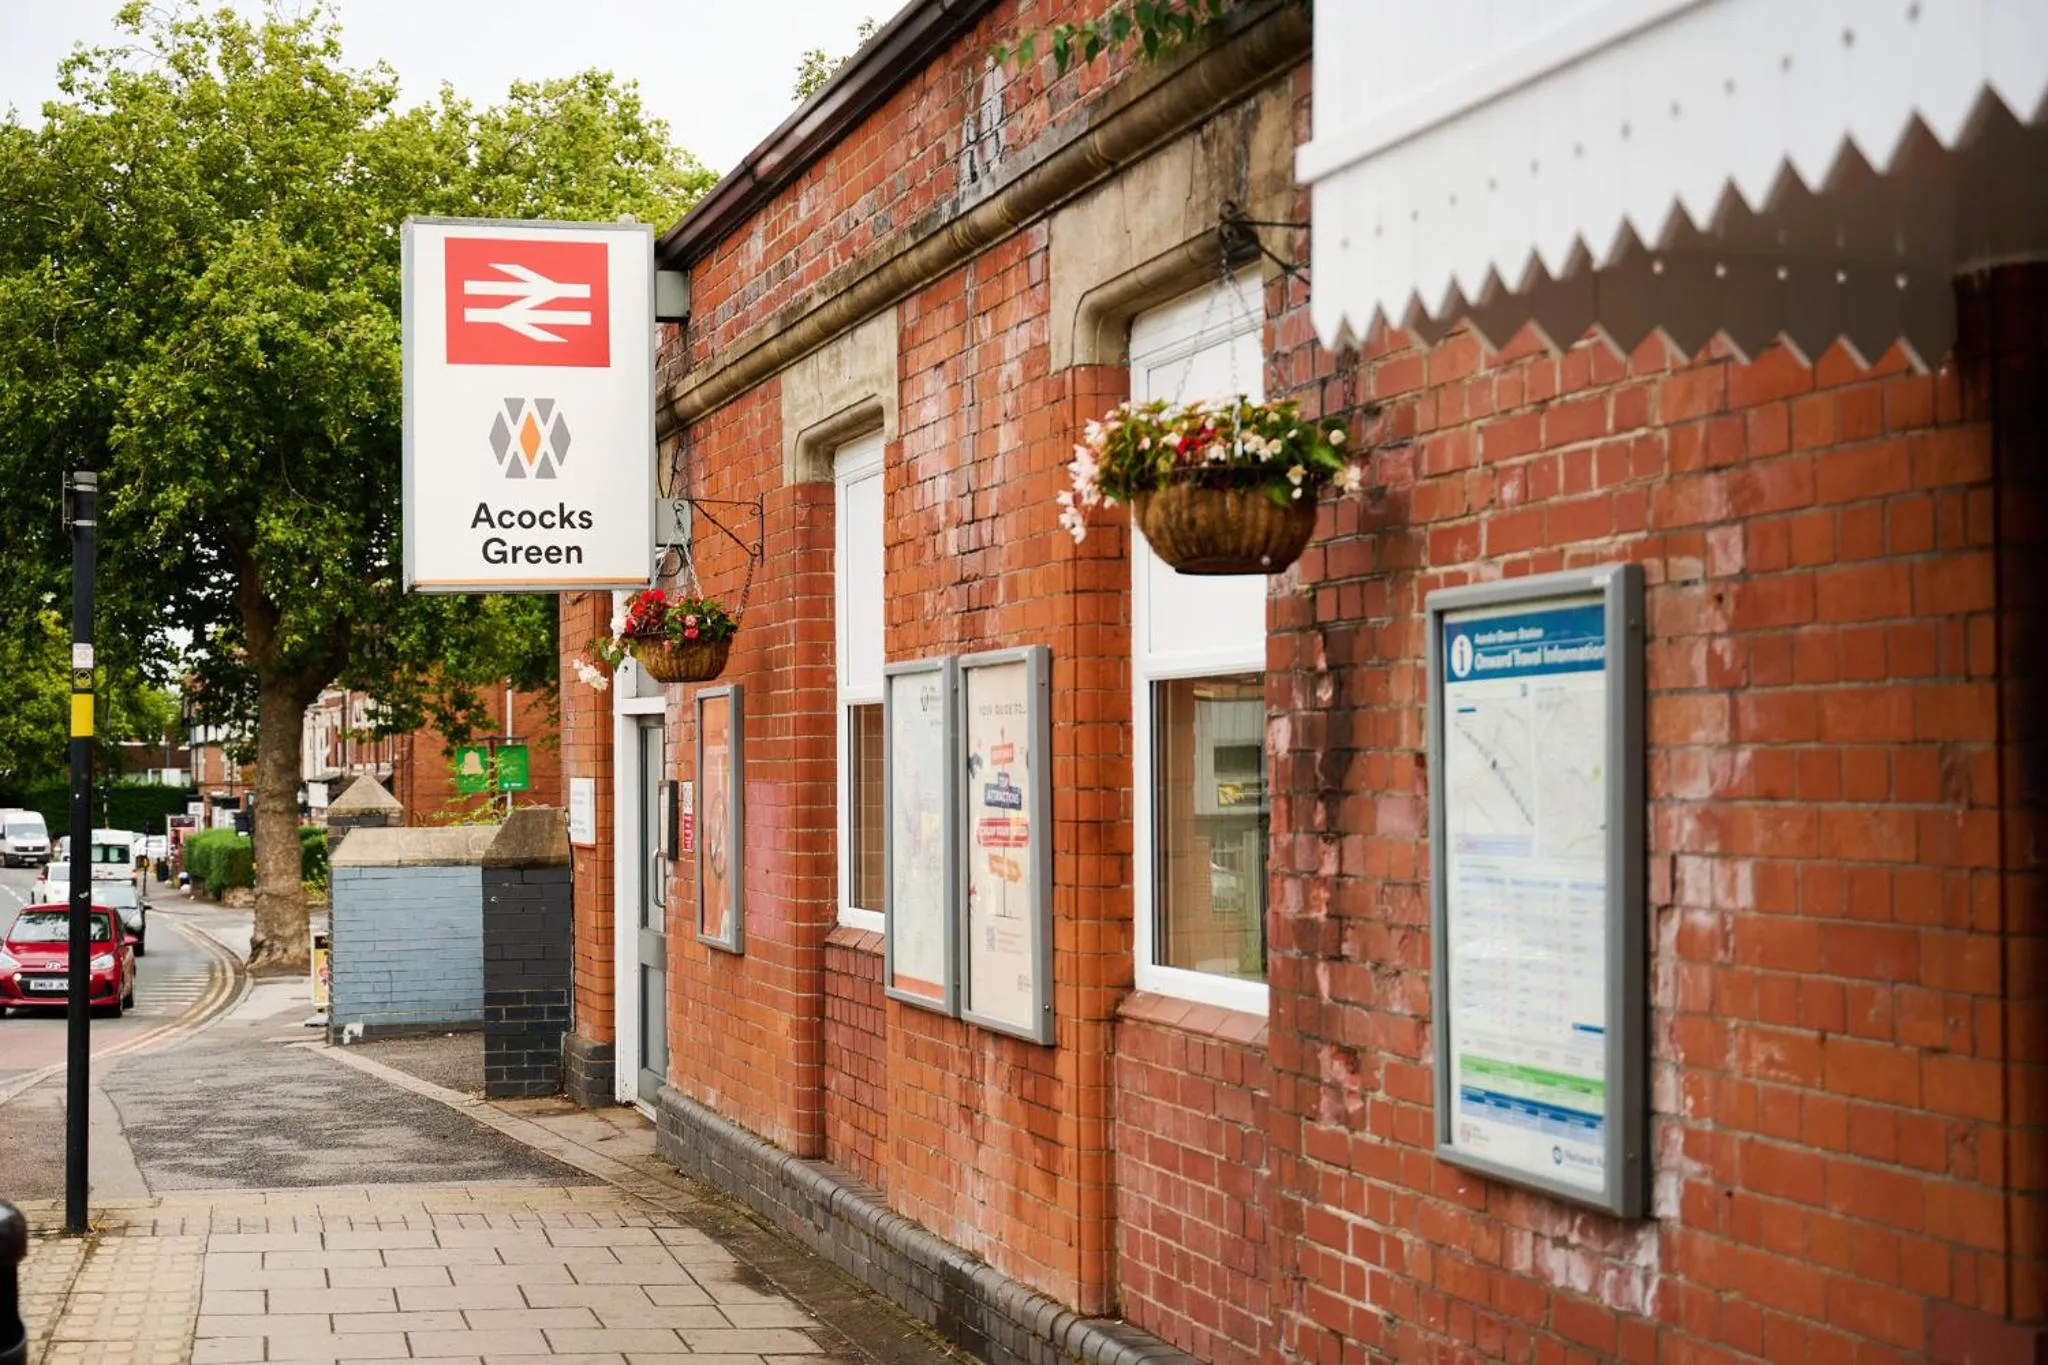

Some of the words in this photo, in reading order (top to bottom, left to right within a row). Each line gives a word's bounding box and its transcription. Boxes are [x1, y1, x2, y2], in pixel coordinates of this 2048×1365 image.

[471, 502, 593, 529] Acocks
[482, 537, 583, 564] Green
[1543, 642, 1606, 664] Information
